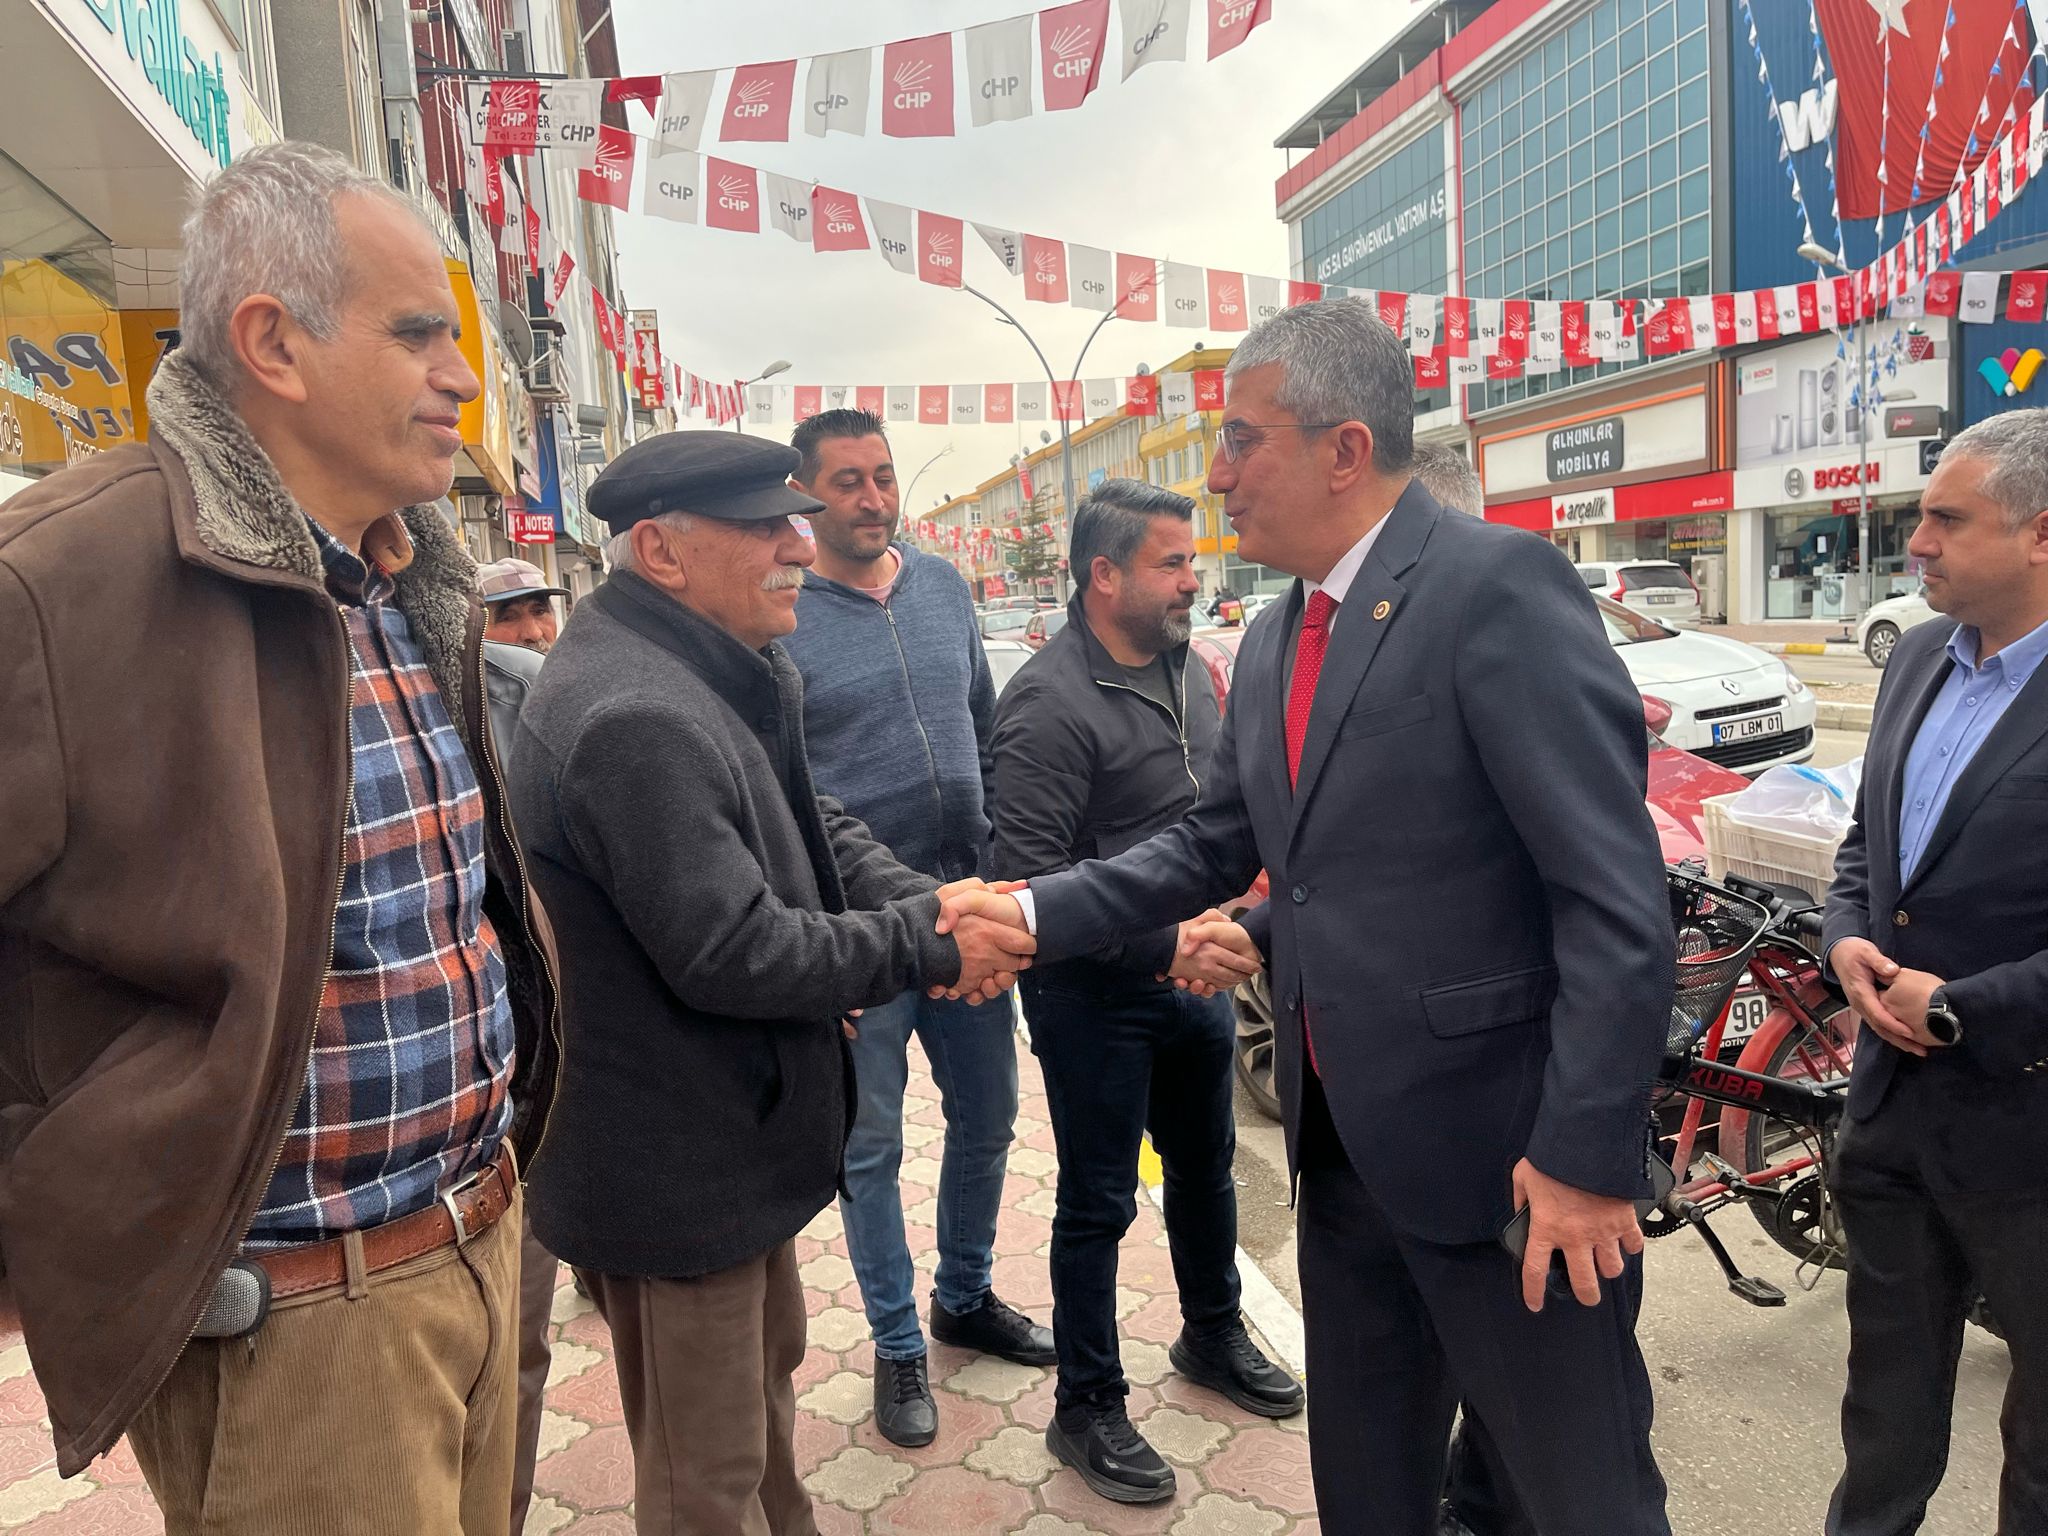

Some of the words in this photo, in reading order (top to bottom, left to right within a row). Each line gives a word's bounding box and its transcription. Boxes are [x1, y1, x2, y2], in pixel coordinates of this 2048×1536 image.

[1217, 2, 1257, 29] CHP
[1133, 21, 1170, 56] CHP
[1052, 57, 1093, 79] CHP
[981, 75, 1019, 99] CHP
[813, 94, 848, 117] CHP
[893, 90, 932, 110] CHP
[500, 112, 527, 127] CHP
[733, 103, 769, 118] CHP
[561, 125, 595, 143] CHP
[661, 114, 690, 135] CHP
[592, 164, 623, 184] CHP
[659, 181, 694, 202] CHP
[718, 196, 750, 213] CHP
[780, 201, 808, 222] CHP
[826, 221, 856, 235] CHP
[1395, 199, 1428, 238] YATIRIM
[881, 237, 907, 257] CHP
[928, 253, 953, 269] CHP
[1035, 271, 1057, 285] CHP
[1081, 278, 1105, 295] CHP
[1127, 290, 1150, 305] CHP
[1174, 298, 1198, 312] CHP
[1218, 302, 1239, 316] CHP
[1552, 422, 1613, 451] ALHUNLAR
[1556, 450, 1610, 476] MOBİLYA
[1814, 462, 1880, 490] BOSCH
[1566, 496, 1607, 525] arçelik
[515, 515, 524, 531] 1.
[525, 515, 554, 532] NOTER
[1720, 725, 1735, 740] 07
[1741, 720, 1763, 736] LBM
[1767, 716, 1780, 731] 01
[1732, 999, 1764, 1033] 98
